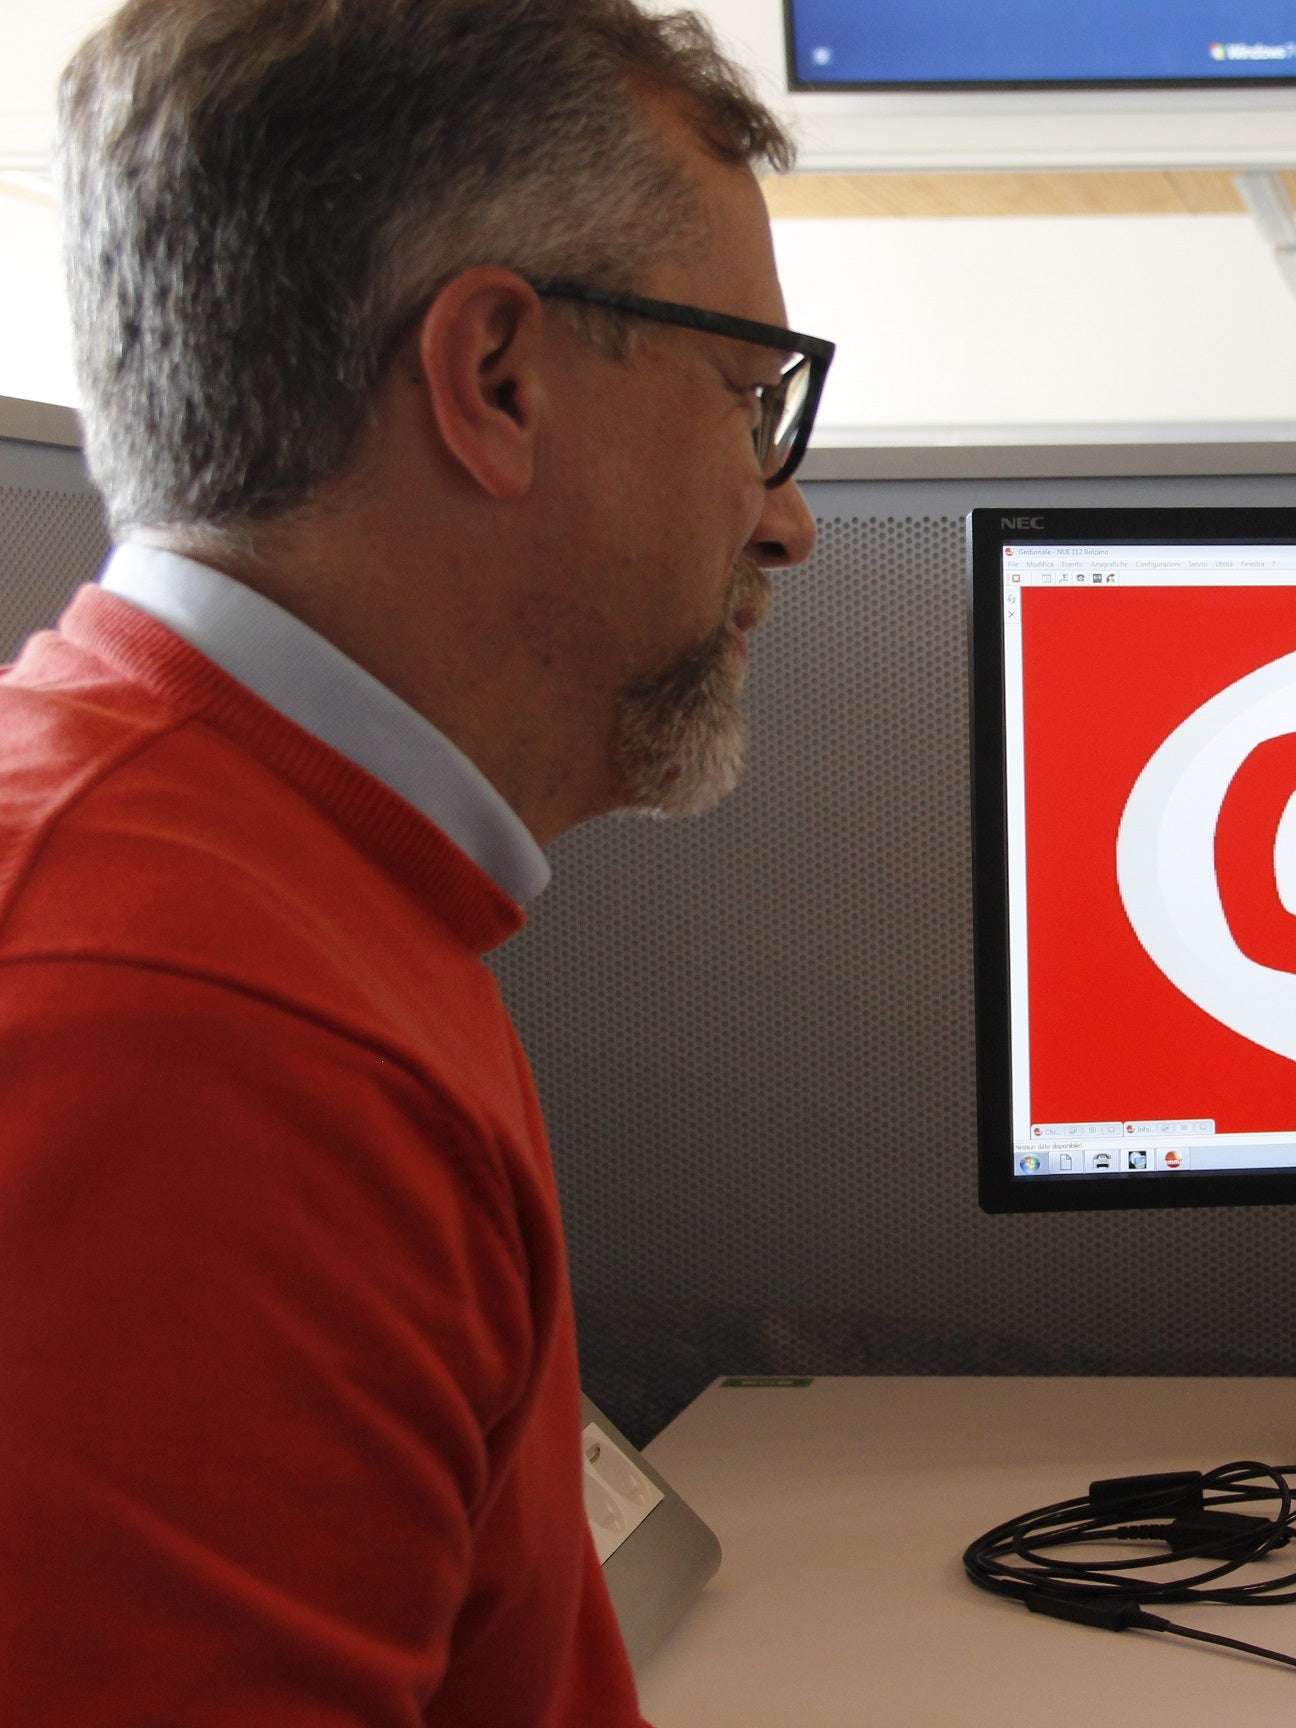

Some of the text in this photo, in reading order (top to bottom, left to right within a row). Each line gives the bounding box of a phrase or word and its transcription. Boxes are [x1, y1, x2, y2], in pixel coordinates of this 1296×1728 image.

[1225, 43, 1285, 60] Windows
[1000, 517, 1045, 529] NEC
[1018, 548, 1050, 556] Gestionale
[1084, 548, 1109, 556] Bolzano
[1090, 561, 1128, 570] Anagrafiche
[1241, 560, 1265, 568] Finestra
